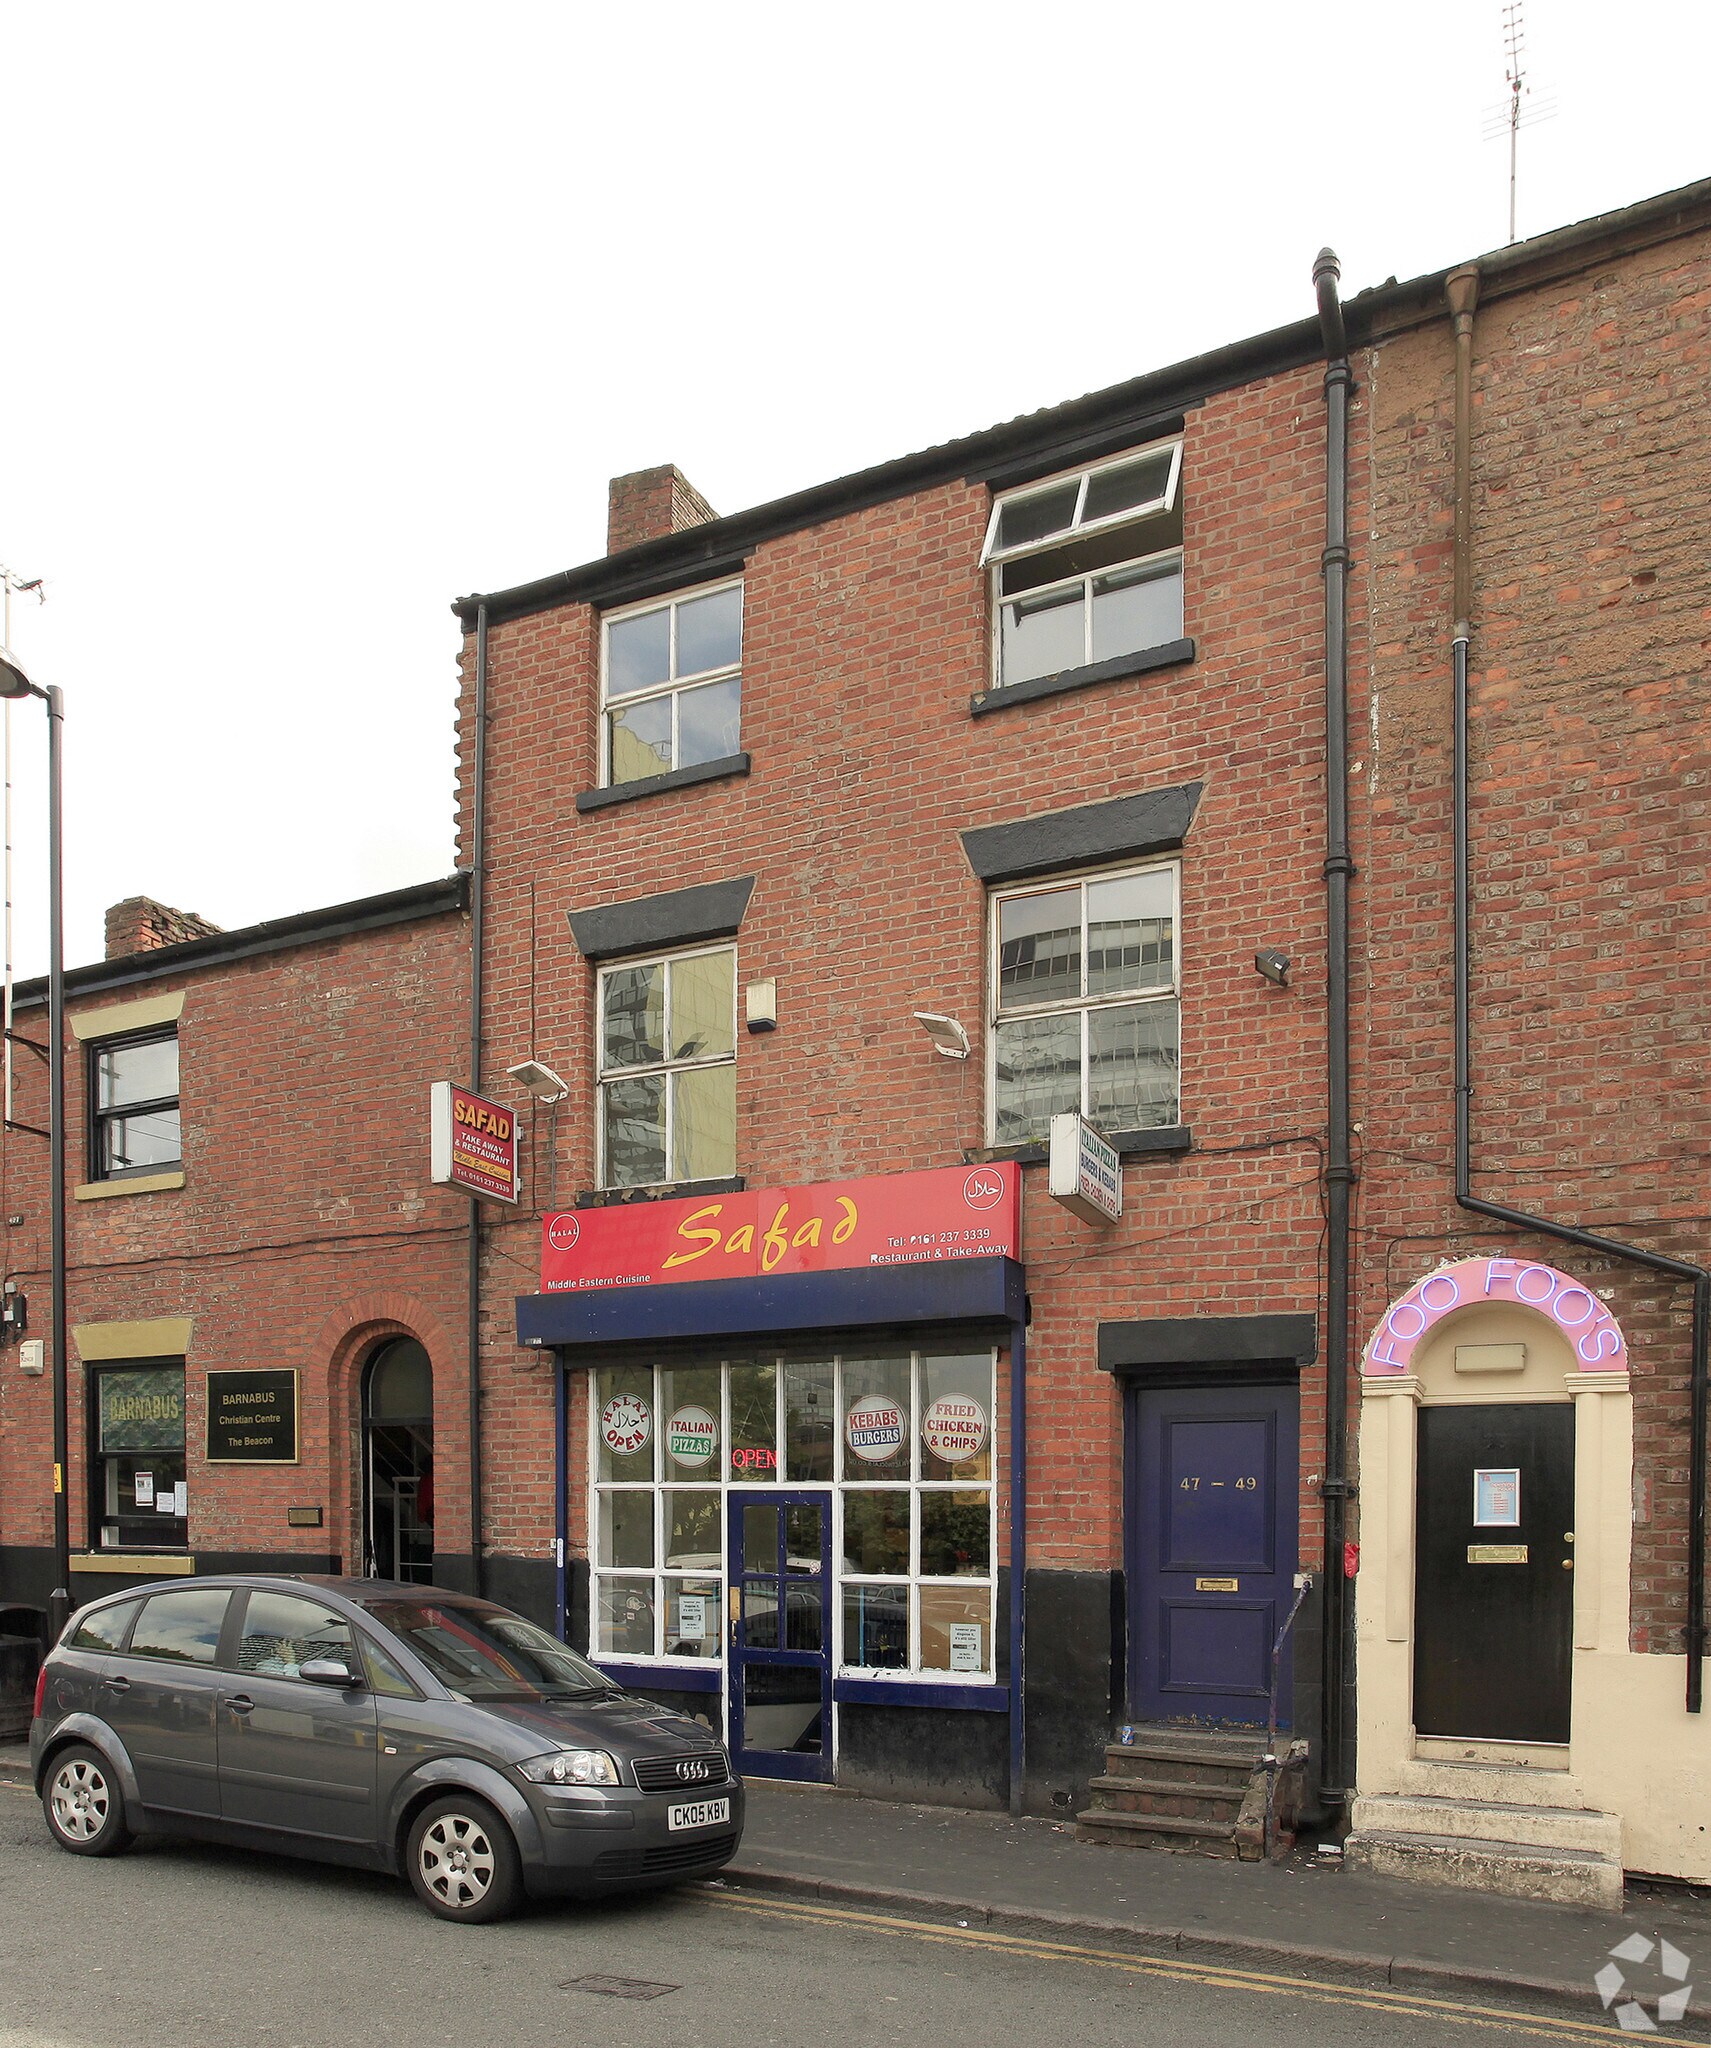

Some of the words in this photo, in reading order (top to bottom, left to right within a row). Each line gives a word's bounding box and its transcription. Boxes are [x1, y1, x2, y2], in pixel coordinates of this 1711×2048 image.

[454, 1100, 510, 1141] SAFAD
[455, 1138, 460, 1146] &
[462, 1142, 510, 1166] RESTAURANT
[461, 1132, 481, 1147] TAKE
[482, 1142, 503, 1154] AWAY
[469, 1172, 484, 1184] 0161
[484, 1179, 495, 1188] 237
[495, 1182, 510, 1193] 3339
[967, 1179, 999, 1198] حلال
[551, 1228, 578, 1238] HALAL
[660, 1196, 858, 1271] Safad
[888, 1236, 906, 1247] Tel:
[940, 1231, 960, 1243] 237
[963, 1228, 990, 1240] 3339
[870, 1249, 931, 1264] Restaurant
[934, 1248, 942, 1258] &
[946, 1244, 1008, 1257] Take-Away
[547, 1279, 577, 1290] Middle
[579, 1276, 613, 1287] Eastern
[615, 1274, 651, 1284] Cuisine
[1371, 1274, 1460, 1369] FOO
[1484, 1258, 1621, 1363] FOO'S
[110, 1394, 179, 1420] BARNABUS
[222, 1392, 276, 1406] BARNABUS
[603, 1396, 648, 1423] HALAL
[935, 1403, 976, 1417] FRIED
[219, 1415, 253, 1425] Christian
[254, 1414, 281, 1423] Centre
[671, 1420, 713, 1434] ITALIAN
[850, 1410, 899, 1429] KEBABS
[927, 1419, 982, 1434] CHICKEN
[228, 1437, 242, 1446] The
[244, 1437, 273, 1446] Beacon
[606, 1429, 645, 1451] OPEN
[672, 1437, 710, 1454] PIZZAS
[853, 1429, 900, 1446] BURGERS
[930, 1435, 938, 1447] &
[942, 1436, 977, 1450] CHIPS
[732, 1448, 777, 1469] OPEN
[1180, 1477, 1200, 1490] 47
[1235, 1477, 1257, 1490] 49
[674, 1805, 705, 1826] CK05
[707, 1801, 726, 1821] KBV
